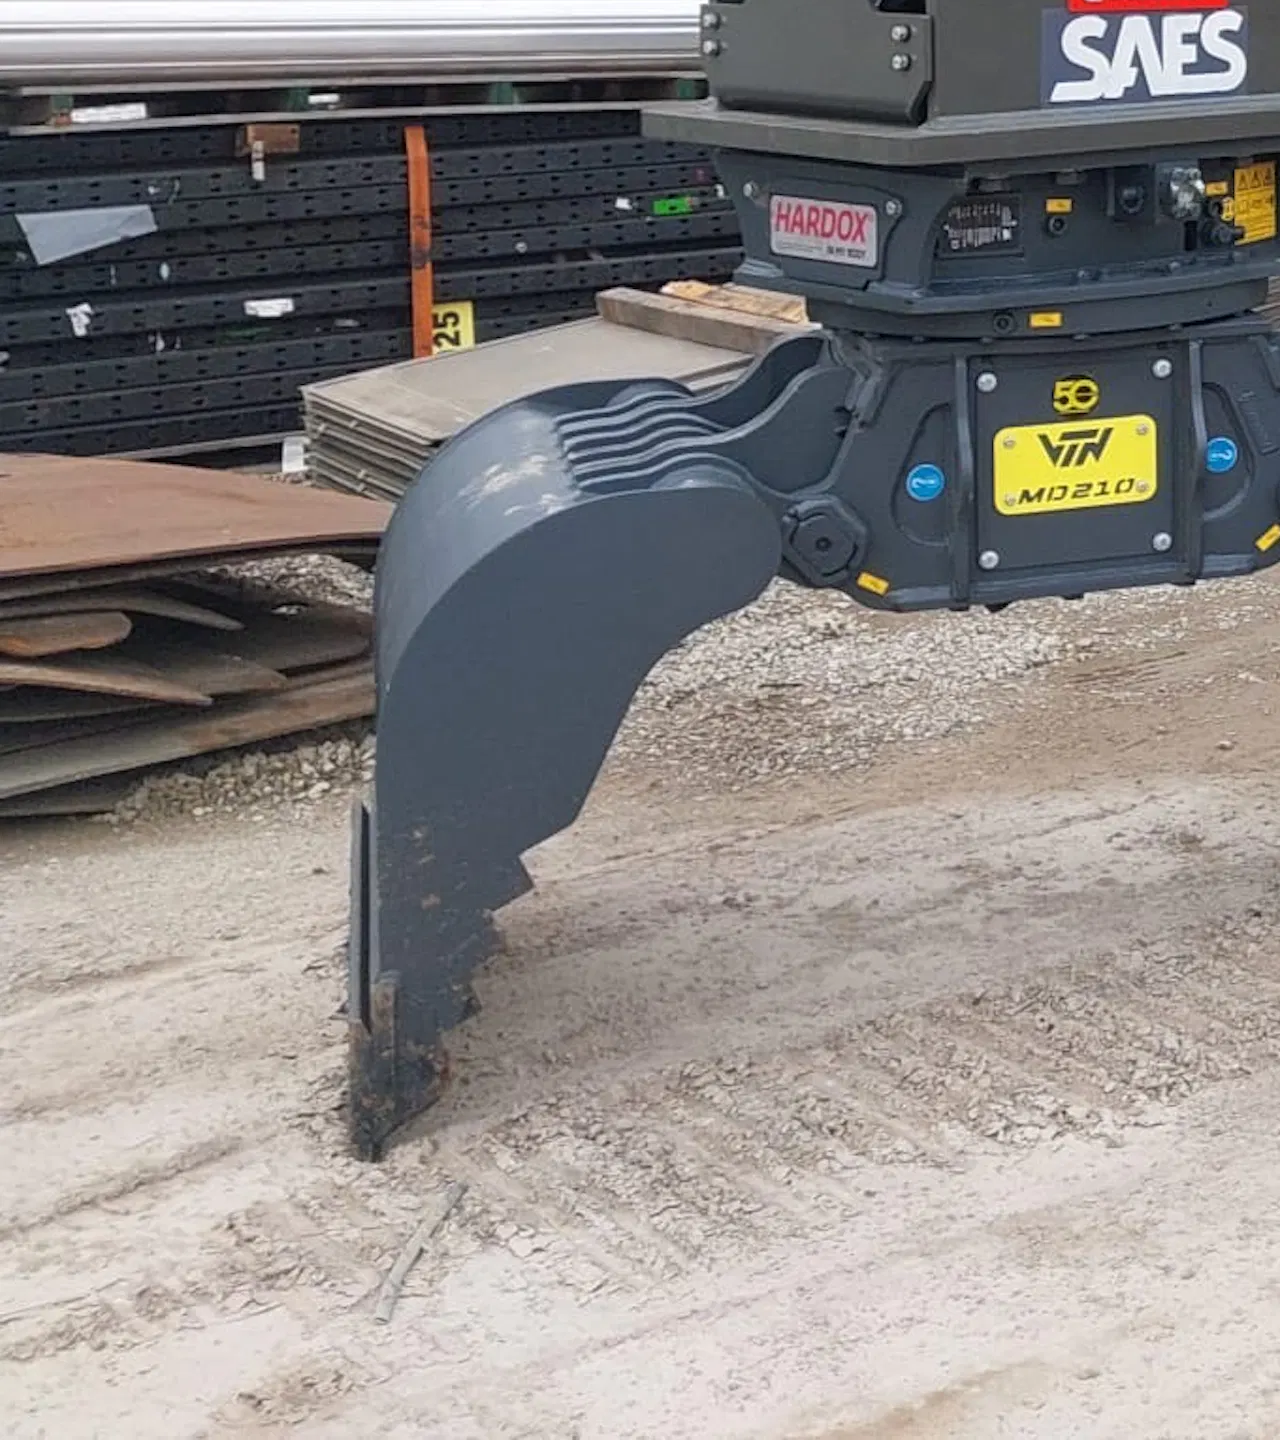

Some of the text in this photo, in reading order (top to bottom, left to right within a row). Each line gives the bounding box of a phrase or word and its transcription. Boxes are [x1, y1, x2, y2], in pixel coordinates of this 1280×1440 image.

[1050, 9, 1248, 102] SAES
[774, 200, 869, 243] HARDOX
[1052, 378, 1099, 415] 50
[1018, 477, 1136, 506] MD210
